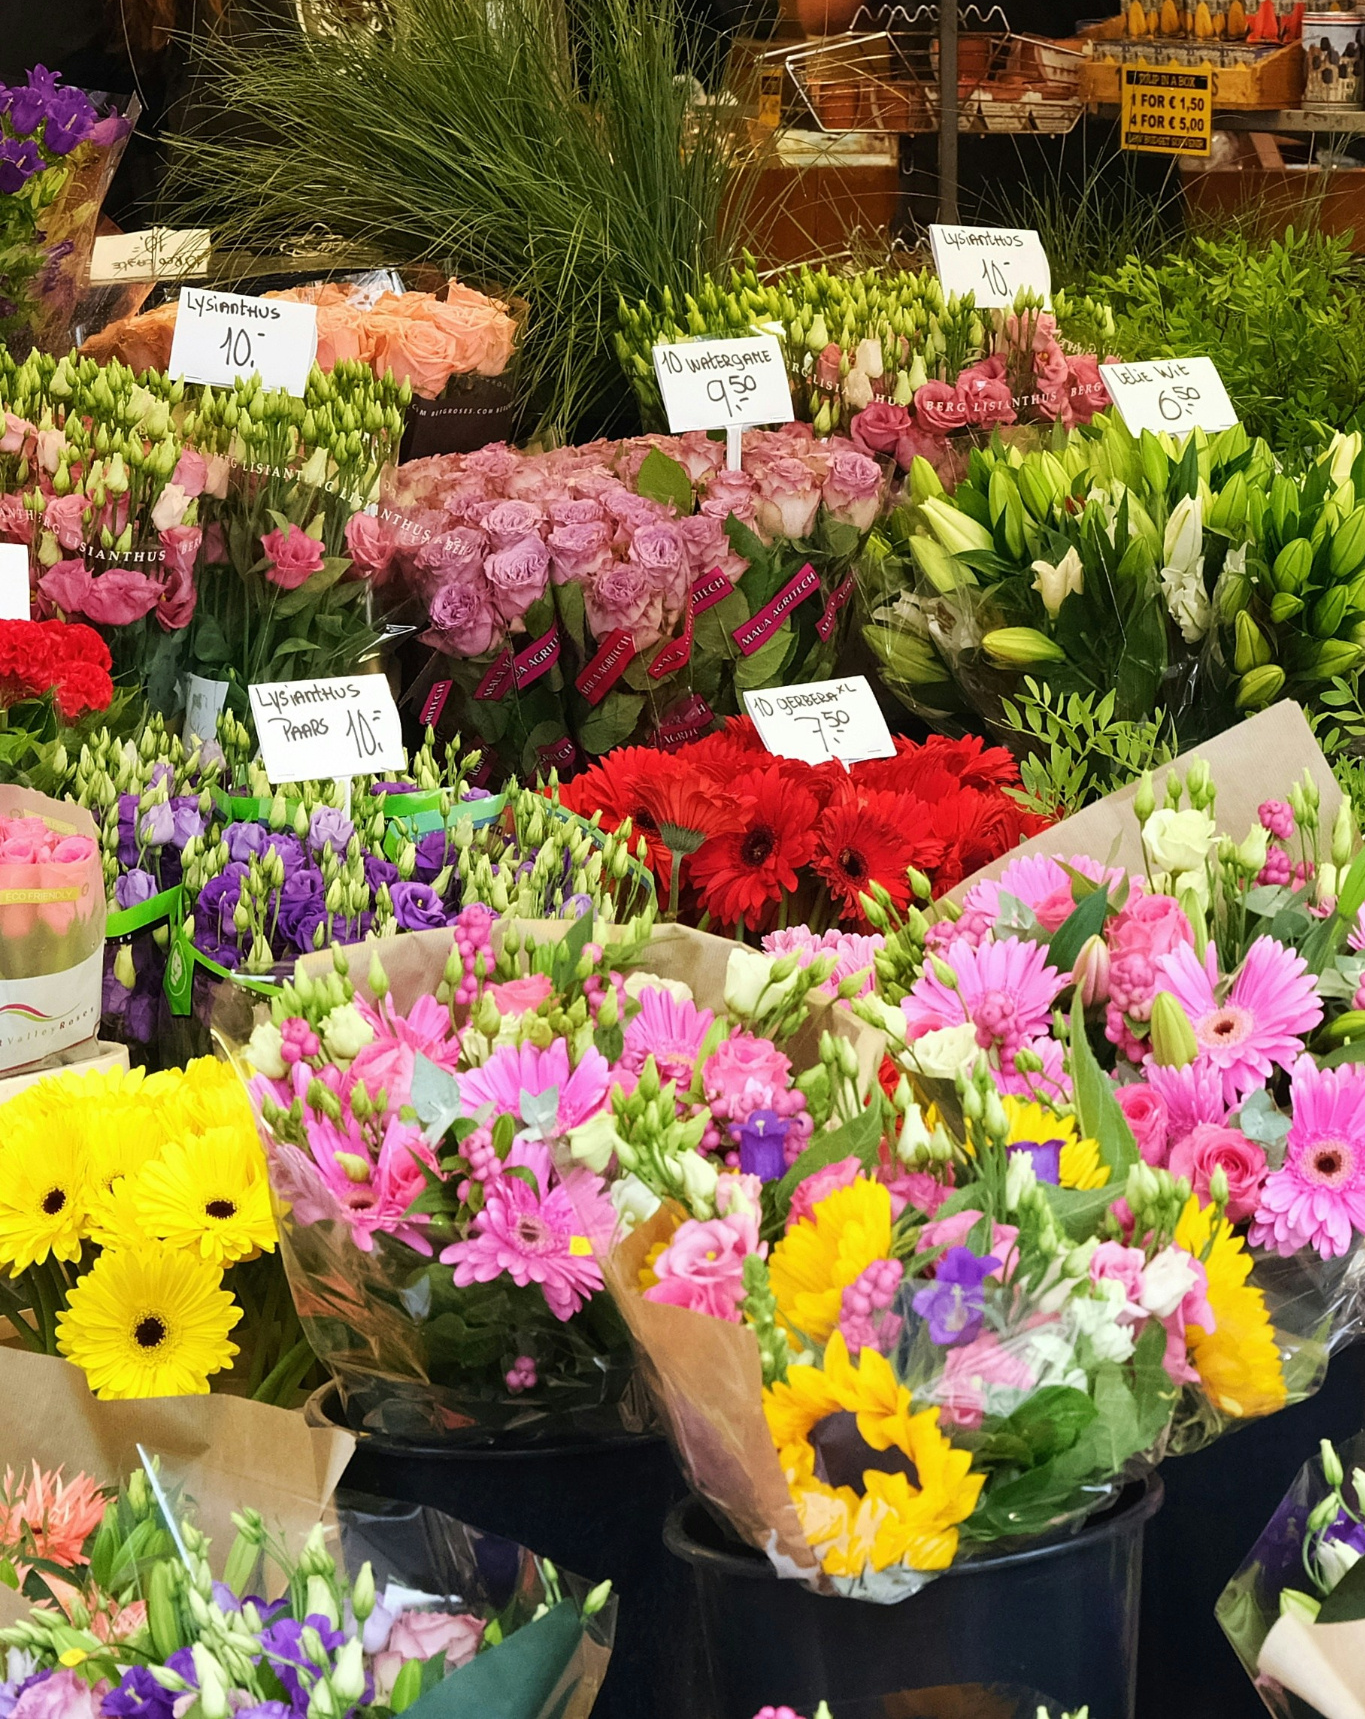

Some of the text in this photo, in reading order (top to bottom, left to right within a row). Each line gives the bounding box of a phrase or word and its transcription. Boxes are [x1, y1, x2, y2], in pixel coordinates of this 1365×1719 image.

[1161, 75, 1169, 85] IN
[1170, 76, 1177, 86] A
[1179, 76, 1196, 87] BOX
[1131, 93, 1204, 113] 1 FOR € 1,50
[1130, 114, 1204, 134] 4 FOR € 5,00
[662, 351, 683, 374] 10
[926, 400, 967, 413] BERG
[973, 391, 1058, 414] LISIANTHUS
[66, 532, 166, 563] LISIANTHUS
[740, 617, 772, 647] MAUA
[771, 572, 816, 618] AGRITECH
[754, 697, 774, 717] 10
[268, 718, 329, 742] PAARS
[6, 890, 73, 902] ECO FRIENDLY
